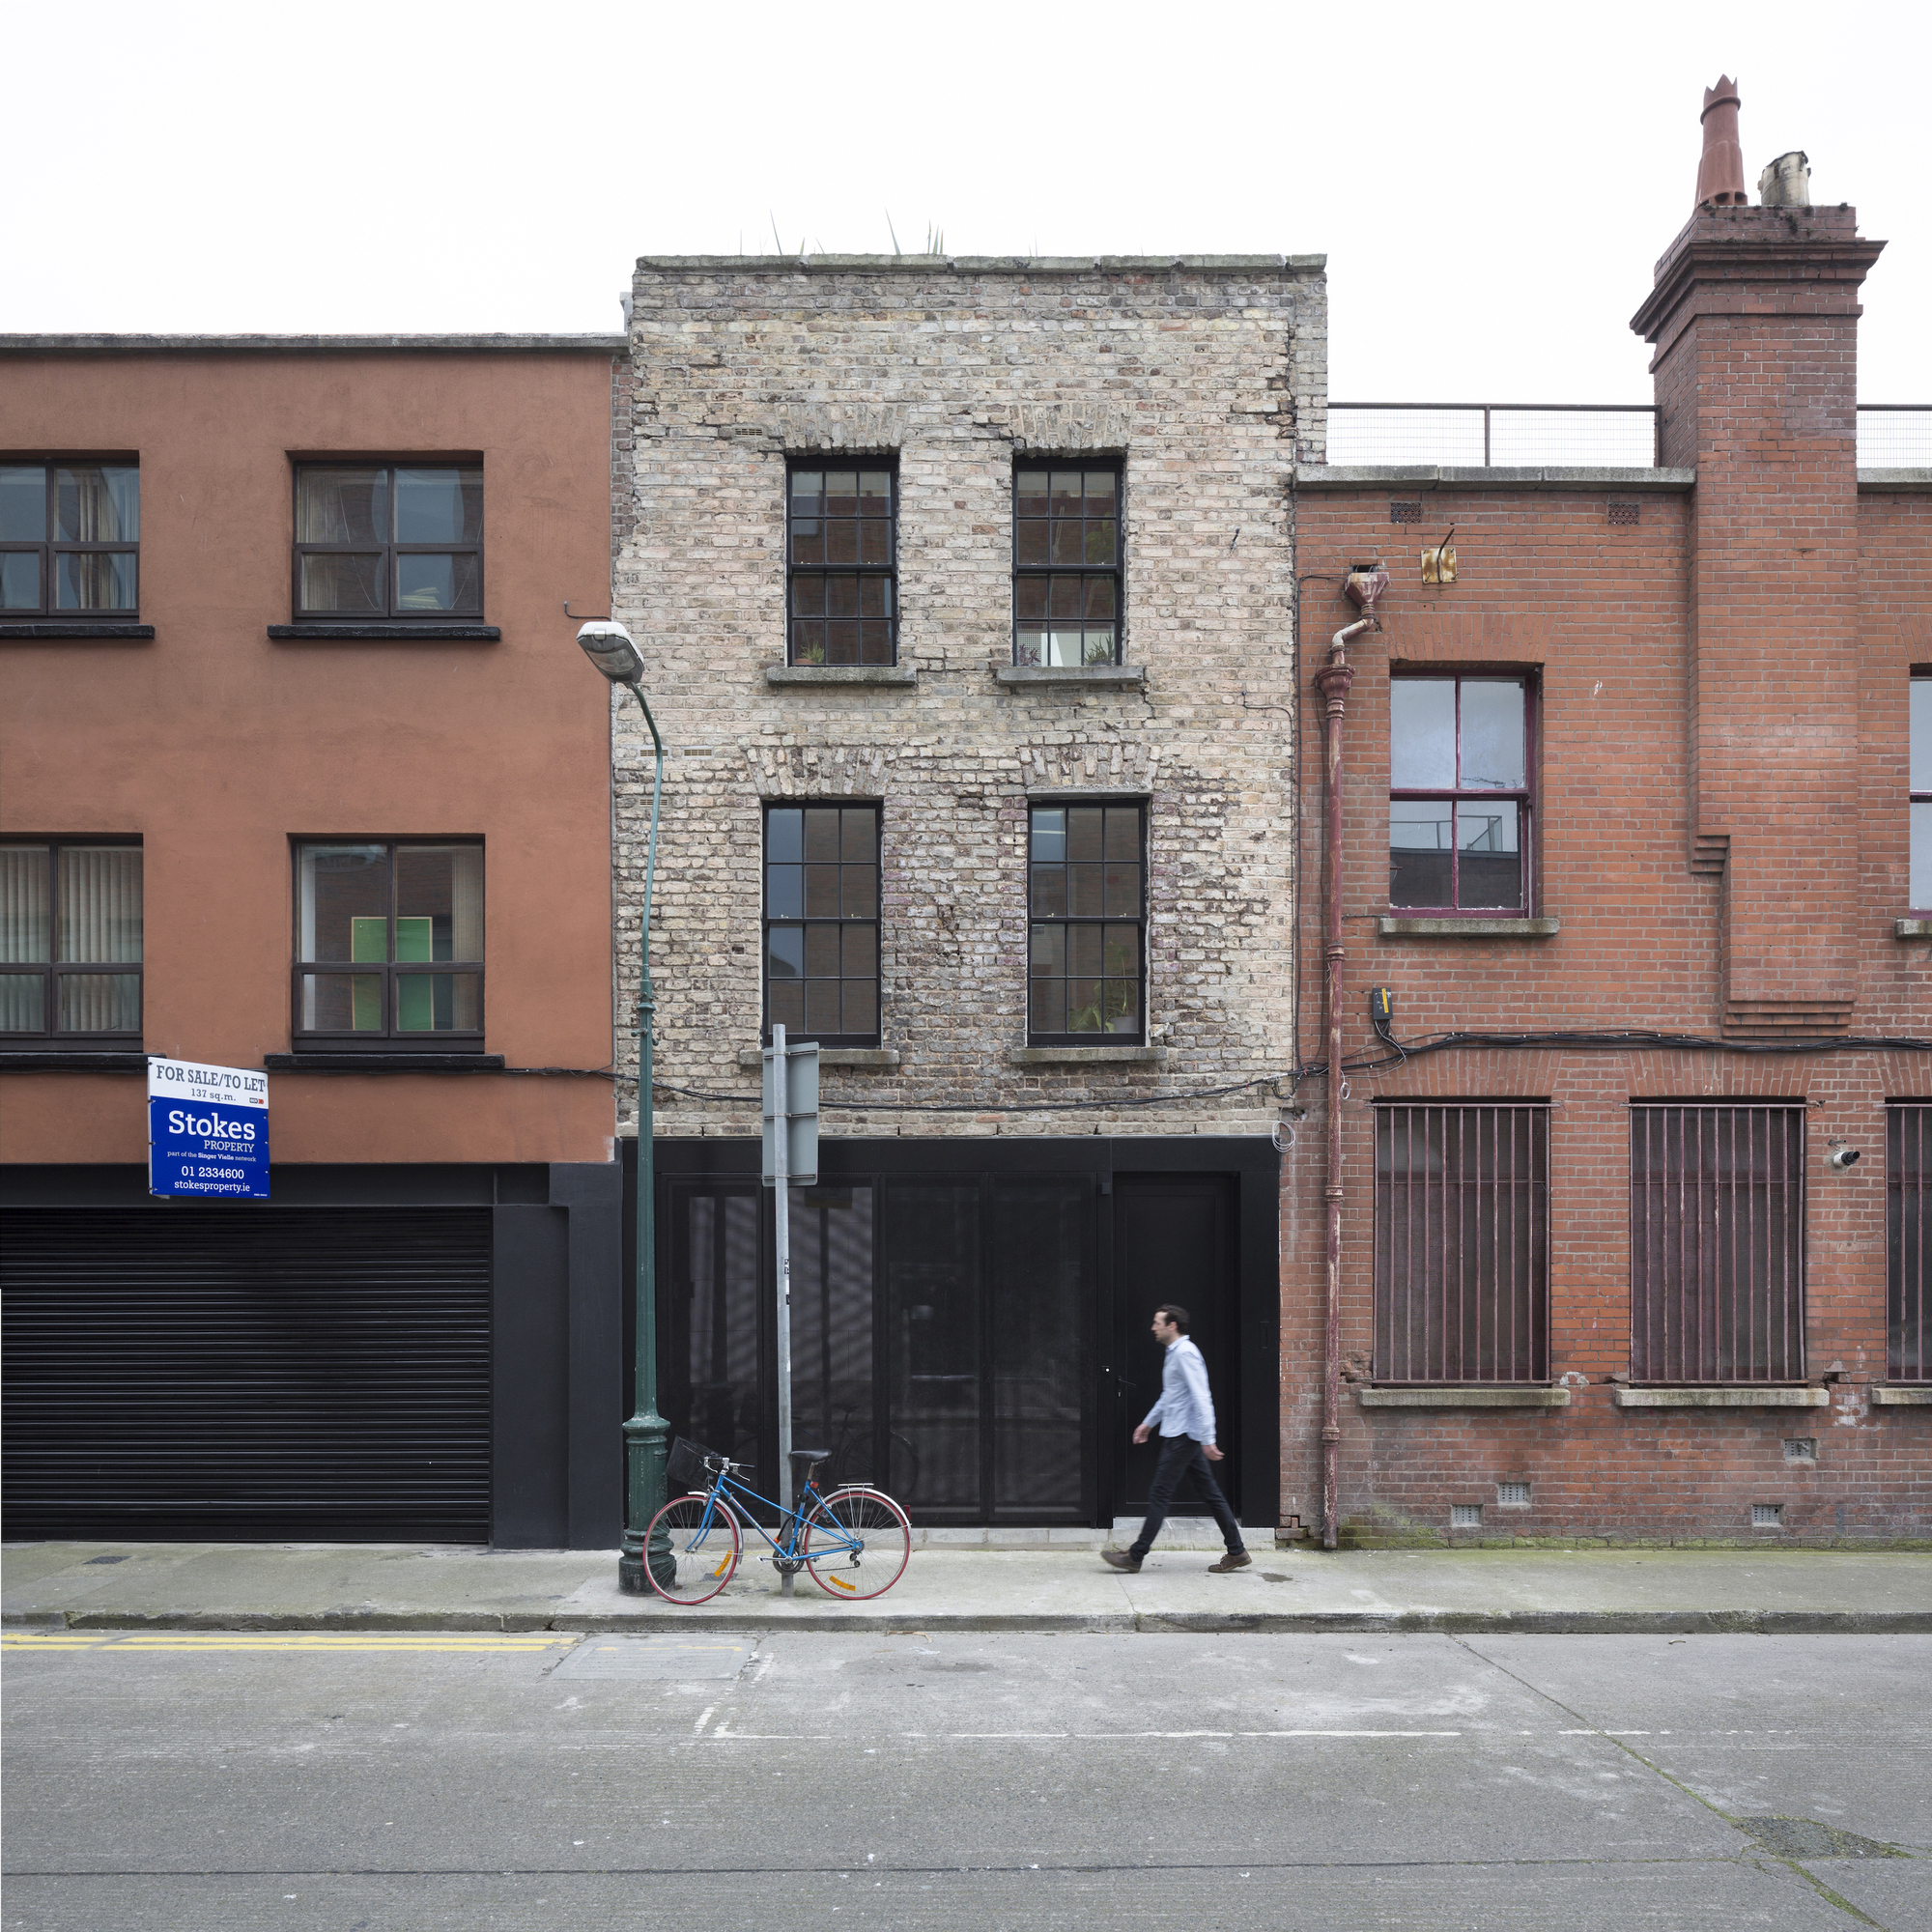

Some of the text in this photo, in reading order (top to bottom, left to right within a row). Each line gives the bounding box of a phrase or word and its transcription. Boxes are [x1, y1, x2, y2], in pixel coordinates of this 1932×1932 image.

[156, 1065, 185, 1082] FOR
[243, 1076, 266, 1093] LET
[191, 1088, 207, 1098] 137
[210, 1092, 237, 1102] sq.m.
[168, 1110, 256, 1141] Stokes
[204, 1140, 254, 1152] PROPERTY
[181, 1165, 244, 1179] 01 2334600
[174, 1179, 250, 1193] stokesproperty.ie
